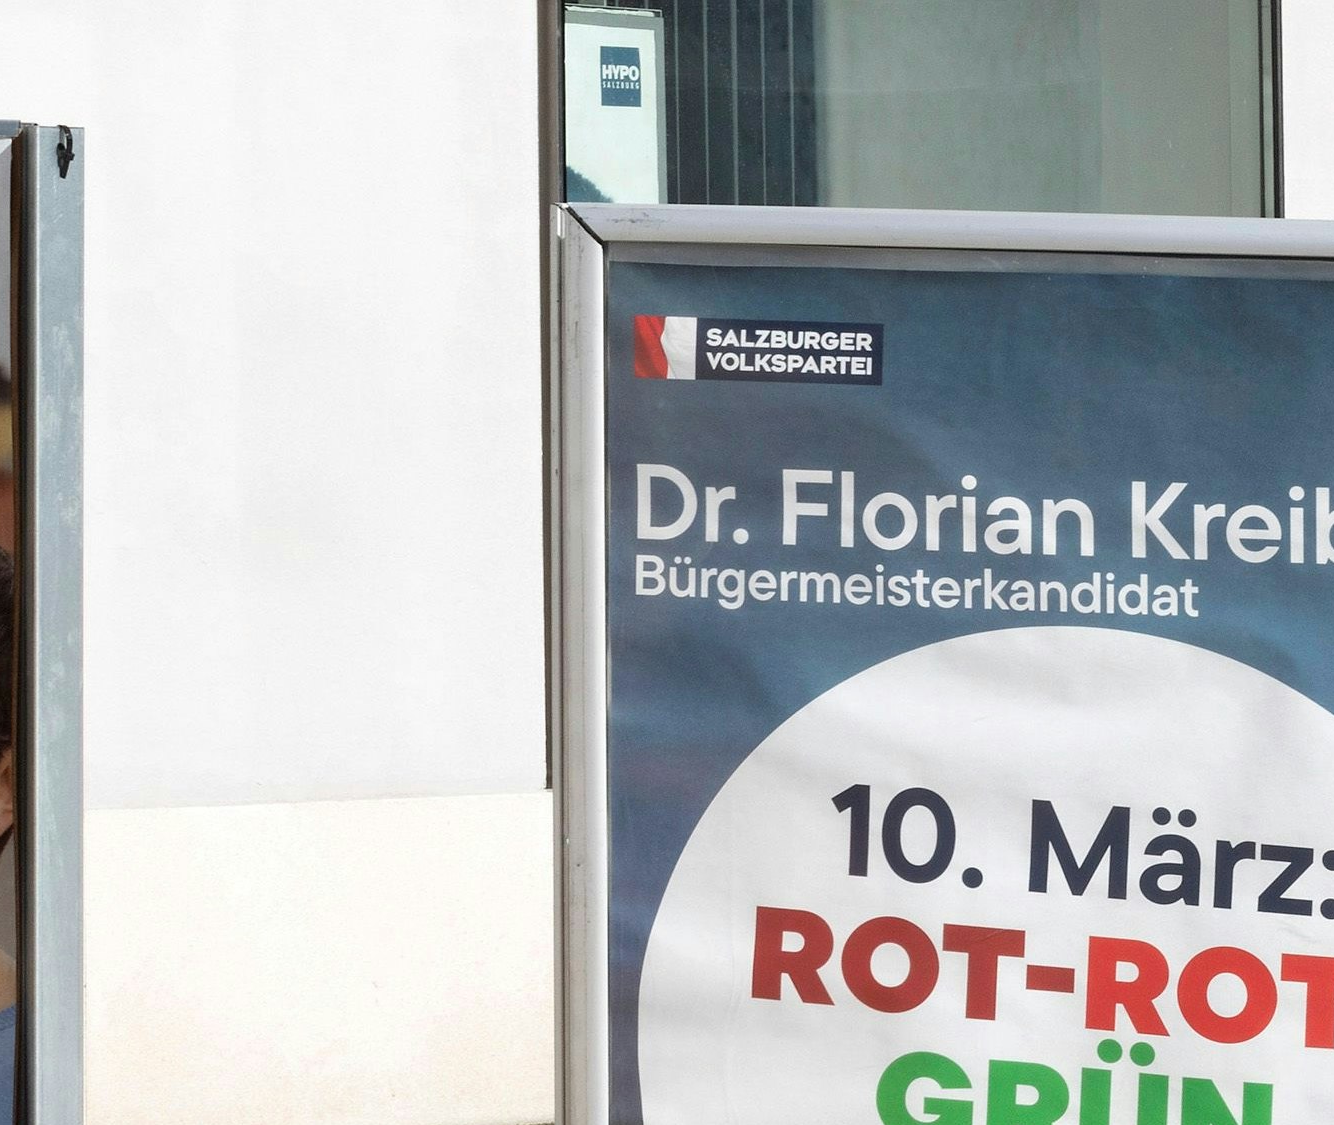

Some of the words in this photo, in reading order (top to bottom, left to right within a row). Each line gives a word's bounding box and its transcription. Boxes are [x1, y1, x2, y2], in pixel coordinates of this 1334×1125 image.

[602, 64, 640, 80] HYPO
[602, 81, 640, 90] SALZBURG
[706, 328, 873, 351] SALZBURGER
[706, 352, 873, 376] VOLKSPARTEI
[636, 463, 750, 545] Dr.
[780, 468, 1097, 558] Florian
[636, 556, 1199, 618] Bürgermeisterkandidat
[831, 783, 983, 889] 10.
